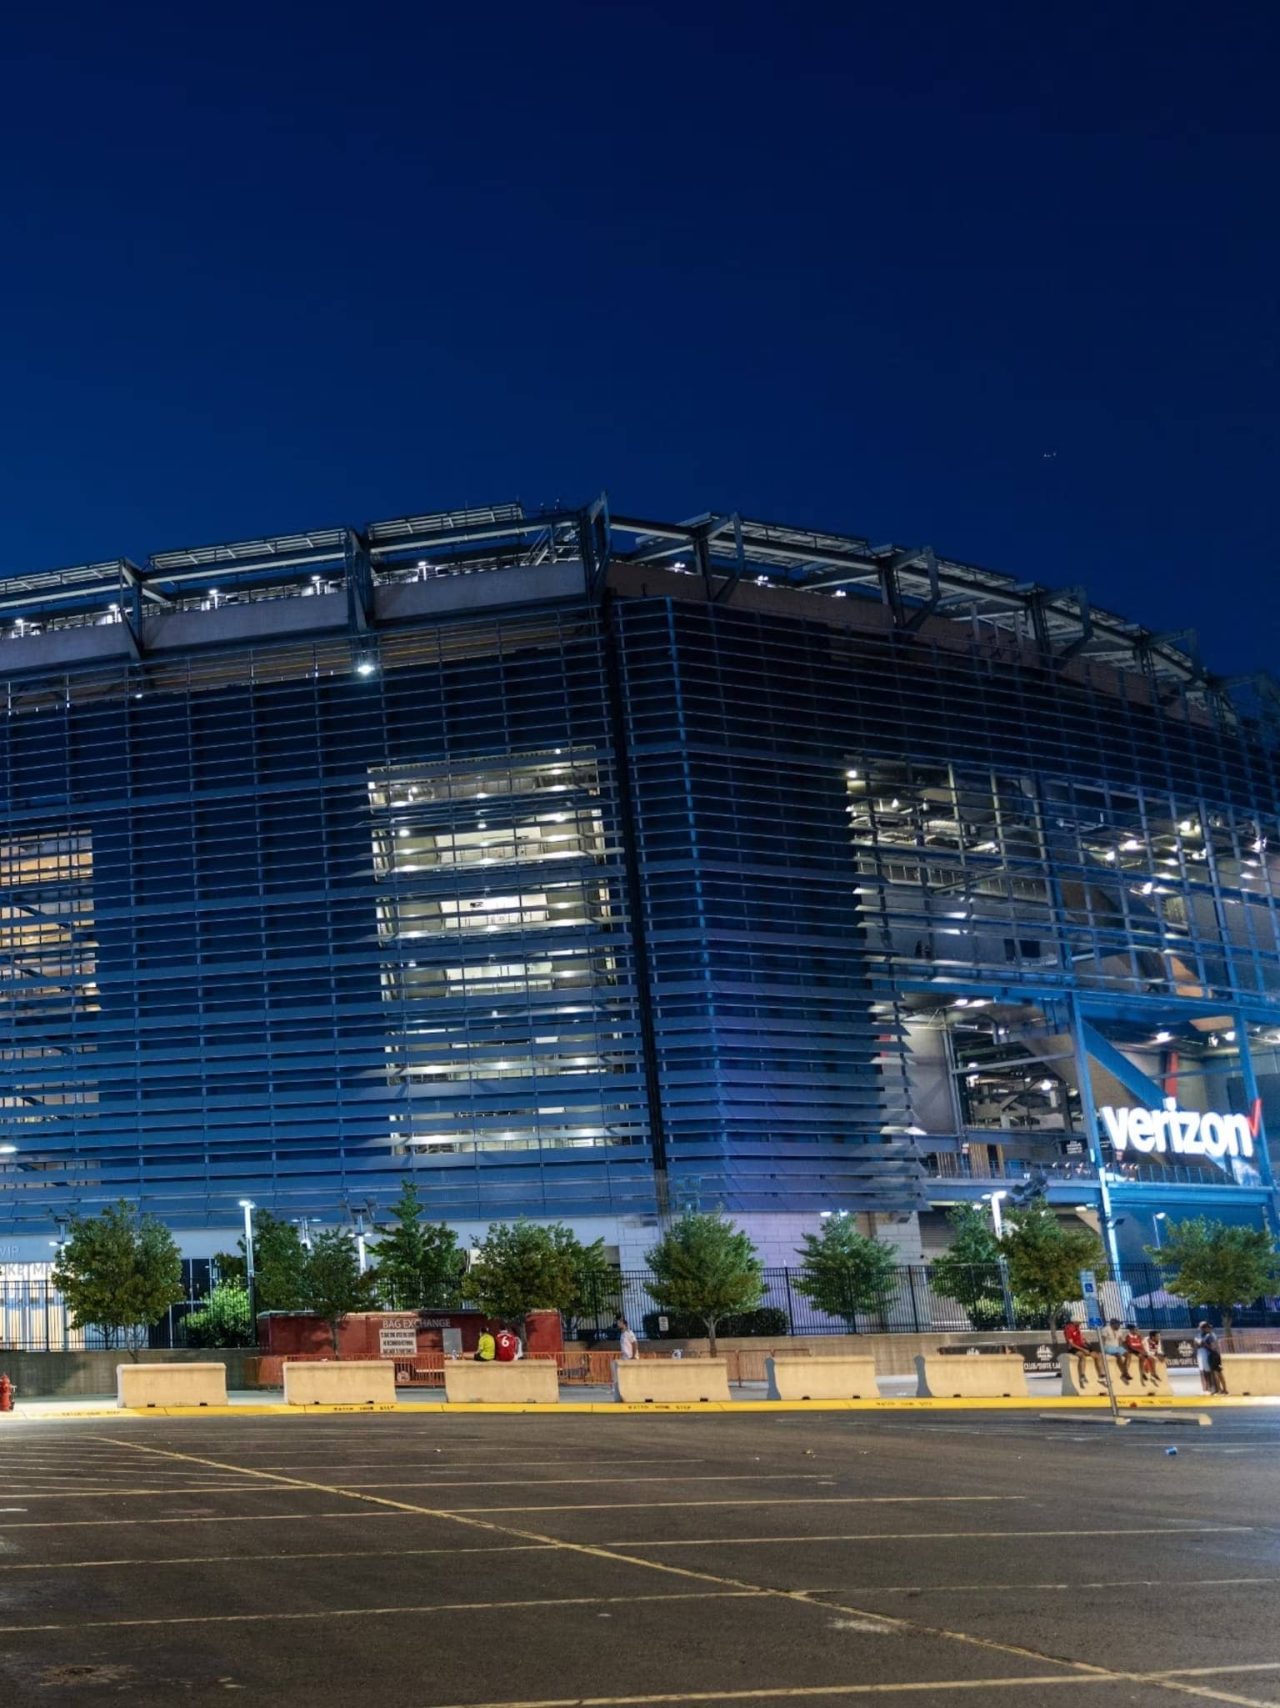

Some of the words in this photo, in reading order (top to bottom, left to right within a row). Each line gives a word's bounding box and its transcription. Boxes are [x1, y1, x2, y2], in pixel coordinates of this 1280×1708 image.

[1101, 1096, 1255, 1157] verizon
[0, 1246, 19, 1257] VIP
[382, 1319, 402, 1329] BAG
[403, 1318, 451, 1328] EXCHANGE
[501, 1336, 510, 1347] 6
